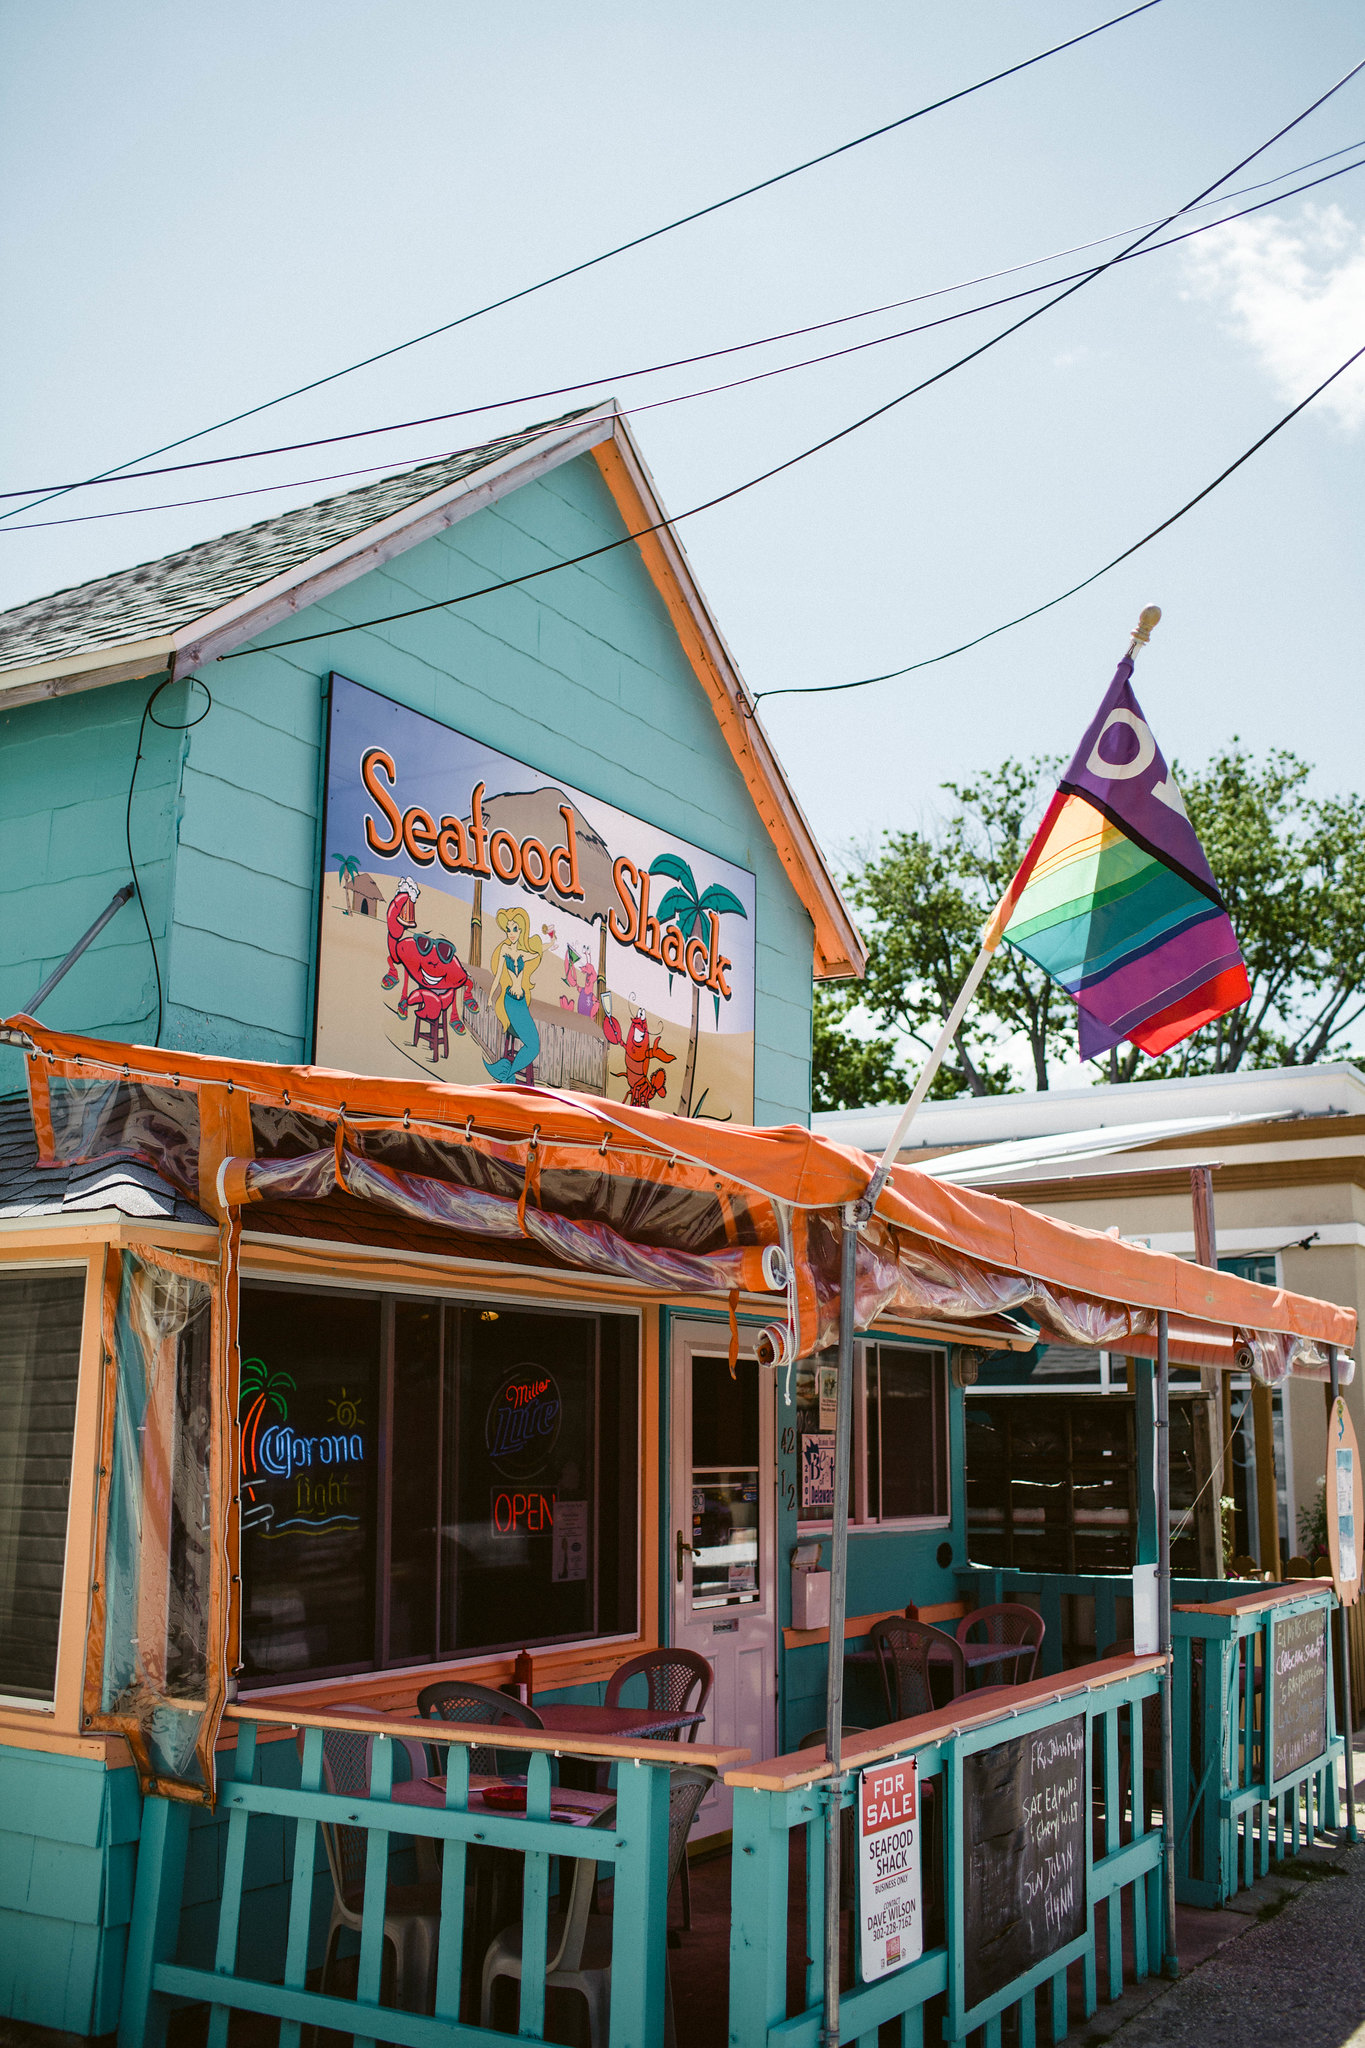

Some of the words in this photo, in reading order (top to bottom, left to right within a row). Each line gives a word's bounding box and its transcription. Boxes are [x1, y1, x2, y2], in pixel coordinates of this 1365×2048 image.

[361, 747, 585, 899] Seafood
[608, 856, 732, 1001] Shack
[505, 1379, 552, 1409] Miller
[490, 1398, 559, 1457] Lite
[781, 1427, 794, 1455] 42
[259, 1425, 363, 1479] Corona
[295, 1473, 349, 1515] Light
[494, 1494, 556, 1532] OPEN
[874, 1773, 904, 1799] FOR
[1045, 1783, 1058, 1812] Ed
[867, 1793, 912, 1826] SALE
[869, 1829, 913, 1860] SEAFOOD
[876, 1849, 908, 1877] SHACK
[875, 1879, 897, 1895] BUSINESS
[897, 1874, 908, 1889] ONLY
[867, 1910, 887, 1931] DAVE
[888, 1899, 916, 1921] WILSON
[883, 1897, 901, 1911] CONTACT
[873, 1915, 912, 1942] 302-228-7162
